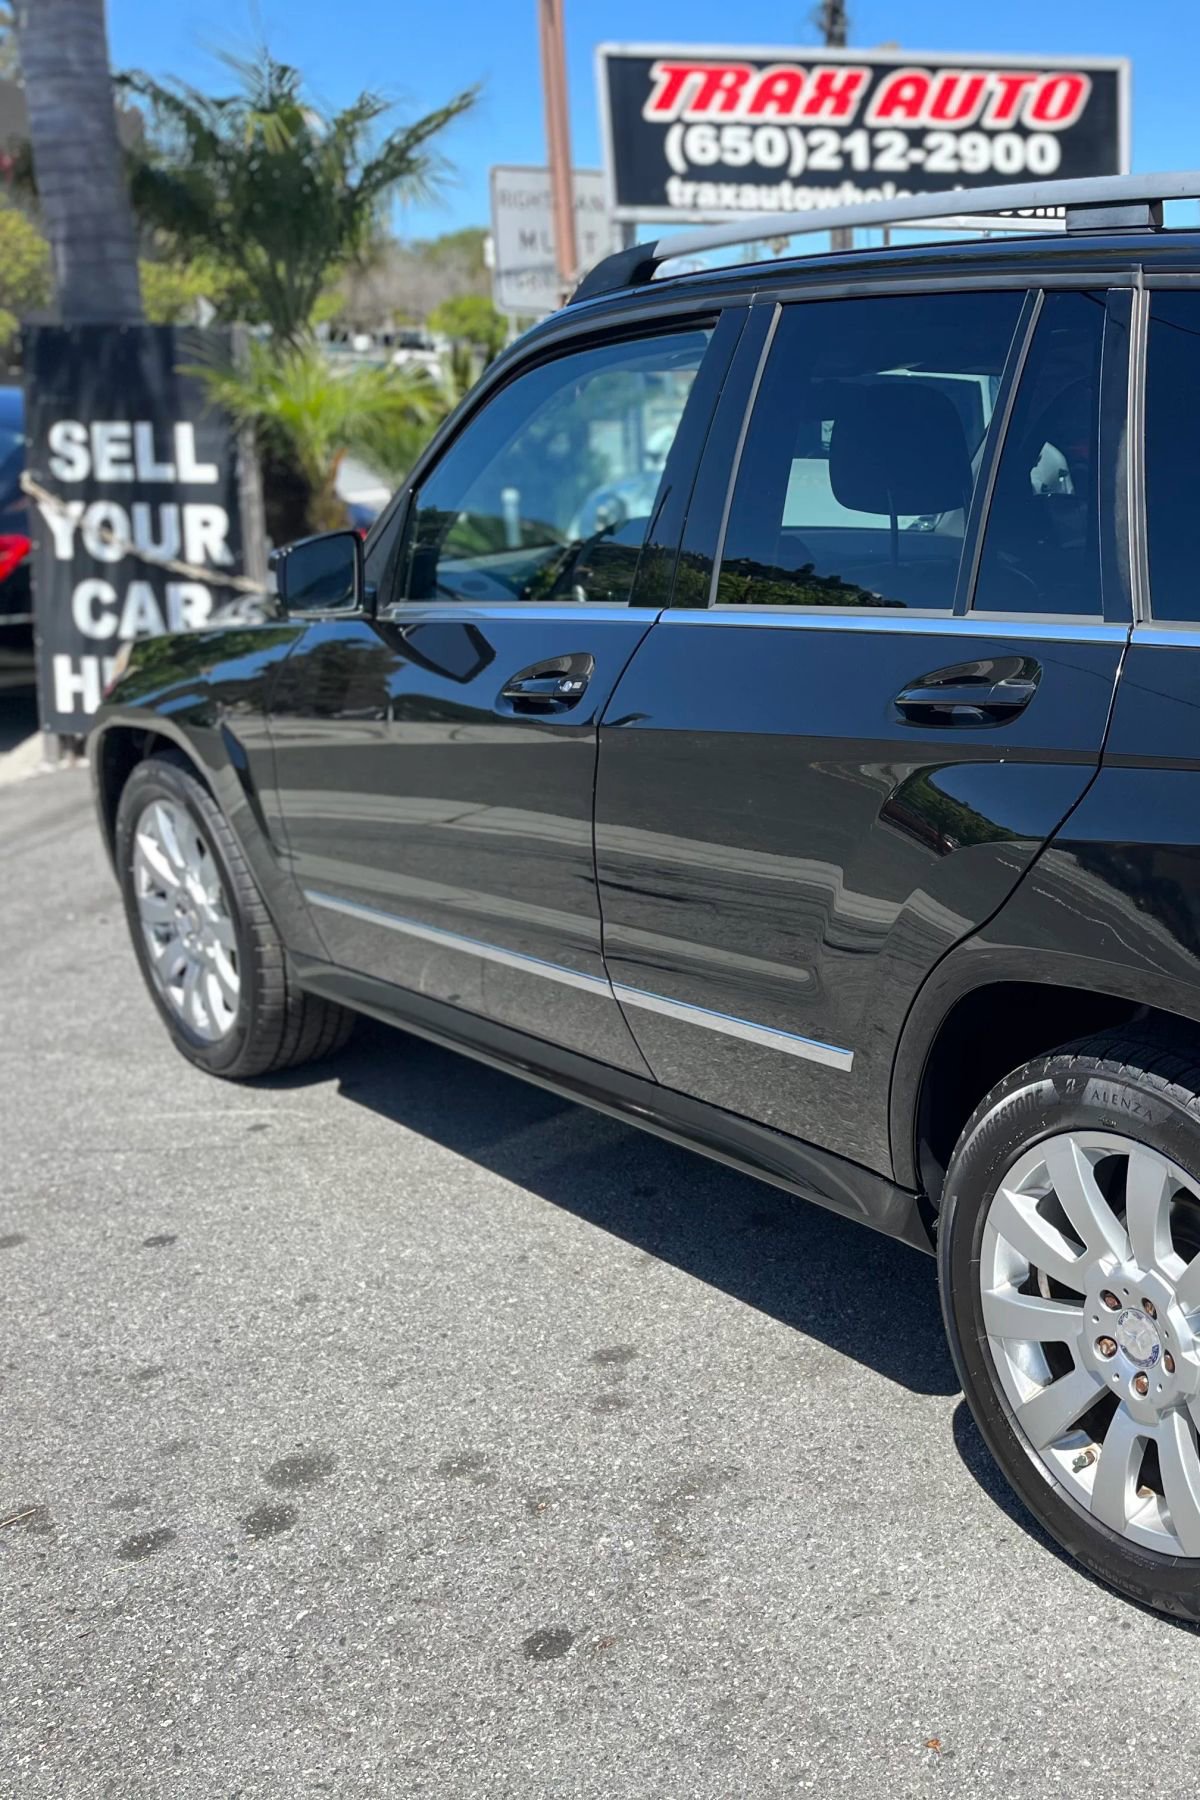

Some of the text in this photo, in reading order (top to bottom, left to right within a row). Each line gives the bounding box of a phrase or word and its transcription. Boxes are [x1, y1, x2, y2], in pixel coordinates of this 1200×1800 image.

[641, 60, 1093, 130] TRAX AUTO
[664, 123, 1062, 177] (650)212-2900
[518, 228, 598, 256] MUT
[48, 420, 219, 484] SELL
[38, 500, 234, 566] YOUR
[72, 578, 214, 641] CAR
[1090, 1088, 1153, 1122] ALENZA
